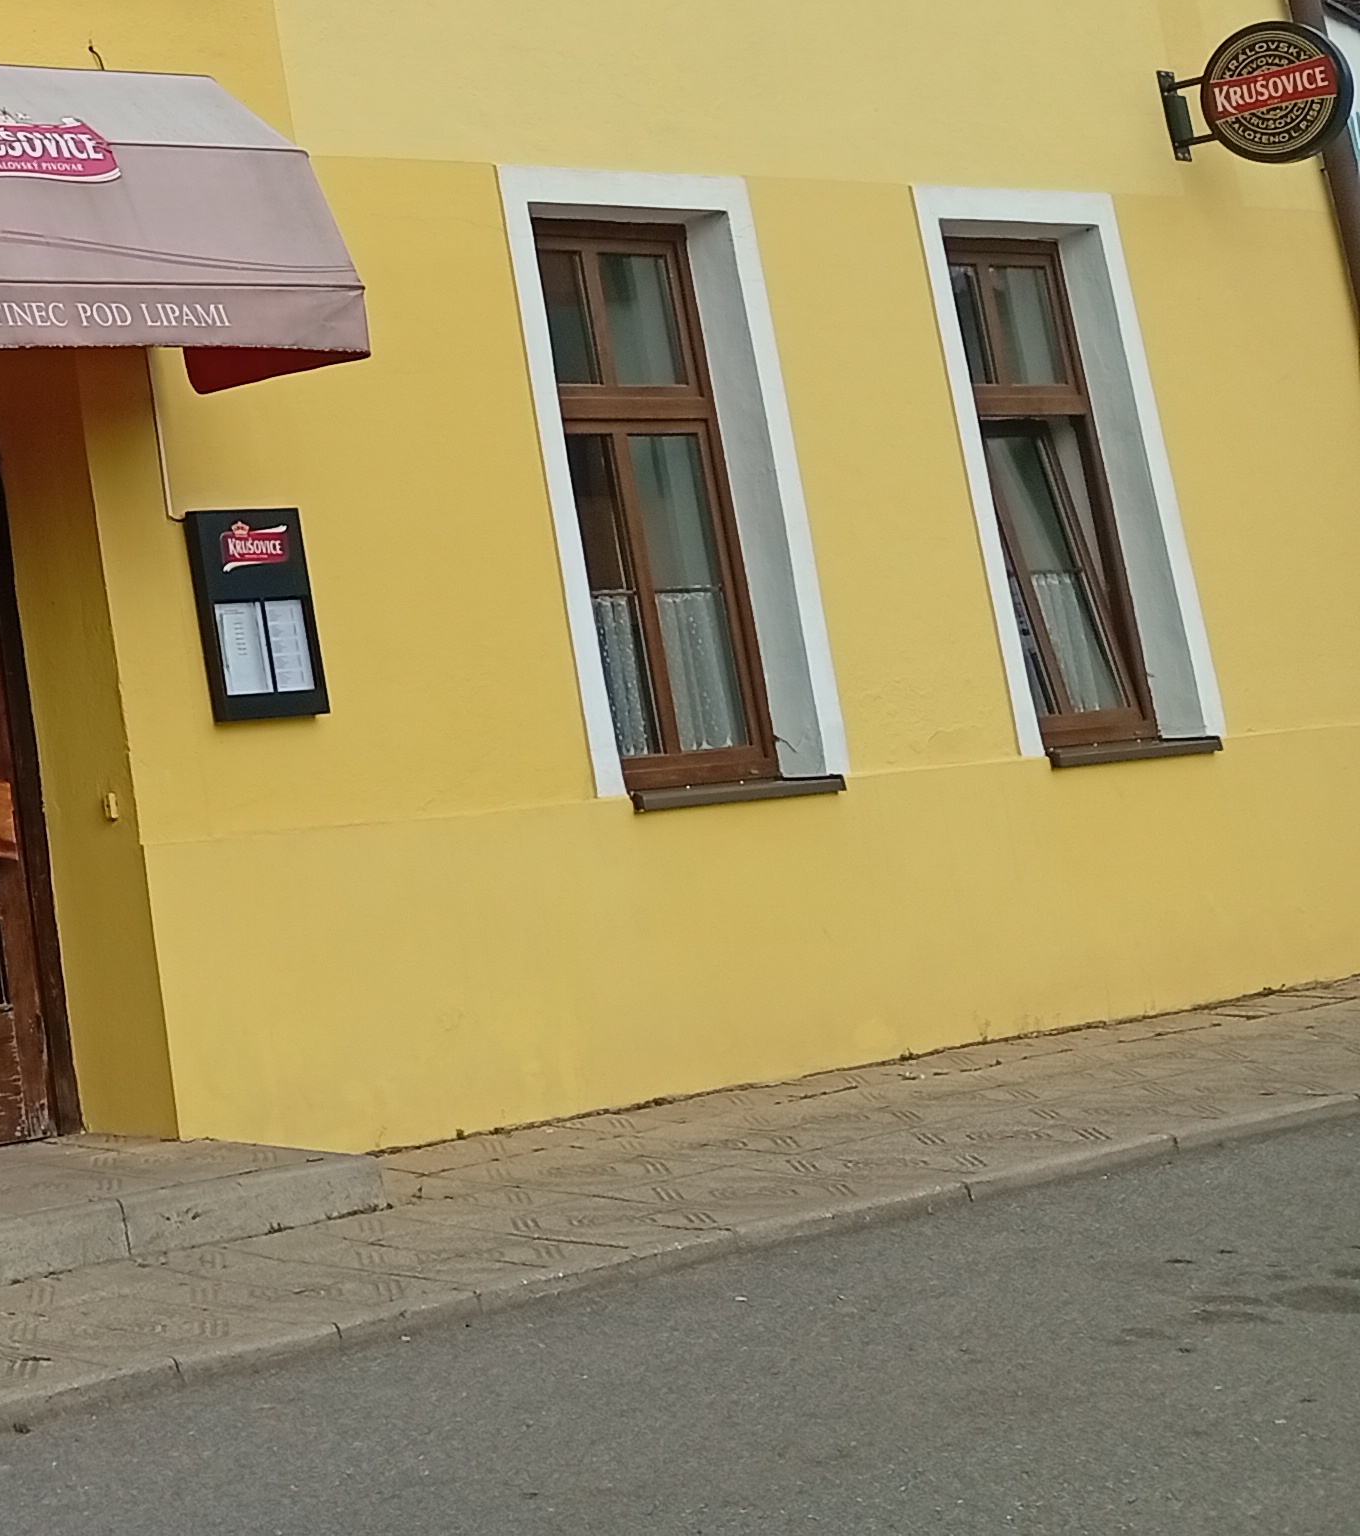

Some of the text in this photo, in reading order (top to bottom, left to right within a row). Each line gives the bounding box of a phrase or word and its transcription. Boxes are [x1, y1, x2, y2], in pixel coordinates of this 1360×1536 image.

[1223, 41, 1310, 79] KRÁLOVSKÝ
[1213, 66, 1329, 114] KRUŠOVICE
[41, 162, 84, 172] PIVOVAR
[75, 302, 132, 327] POD
[139, 303, 231, 327] LIPAMI
[227, 537, 283, 559] KRUŠOVICE
